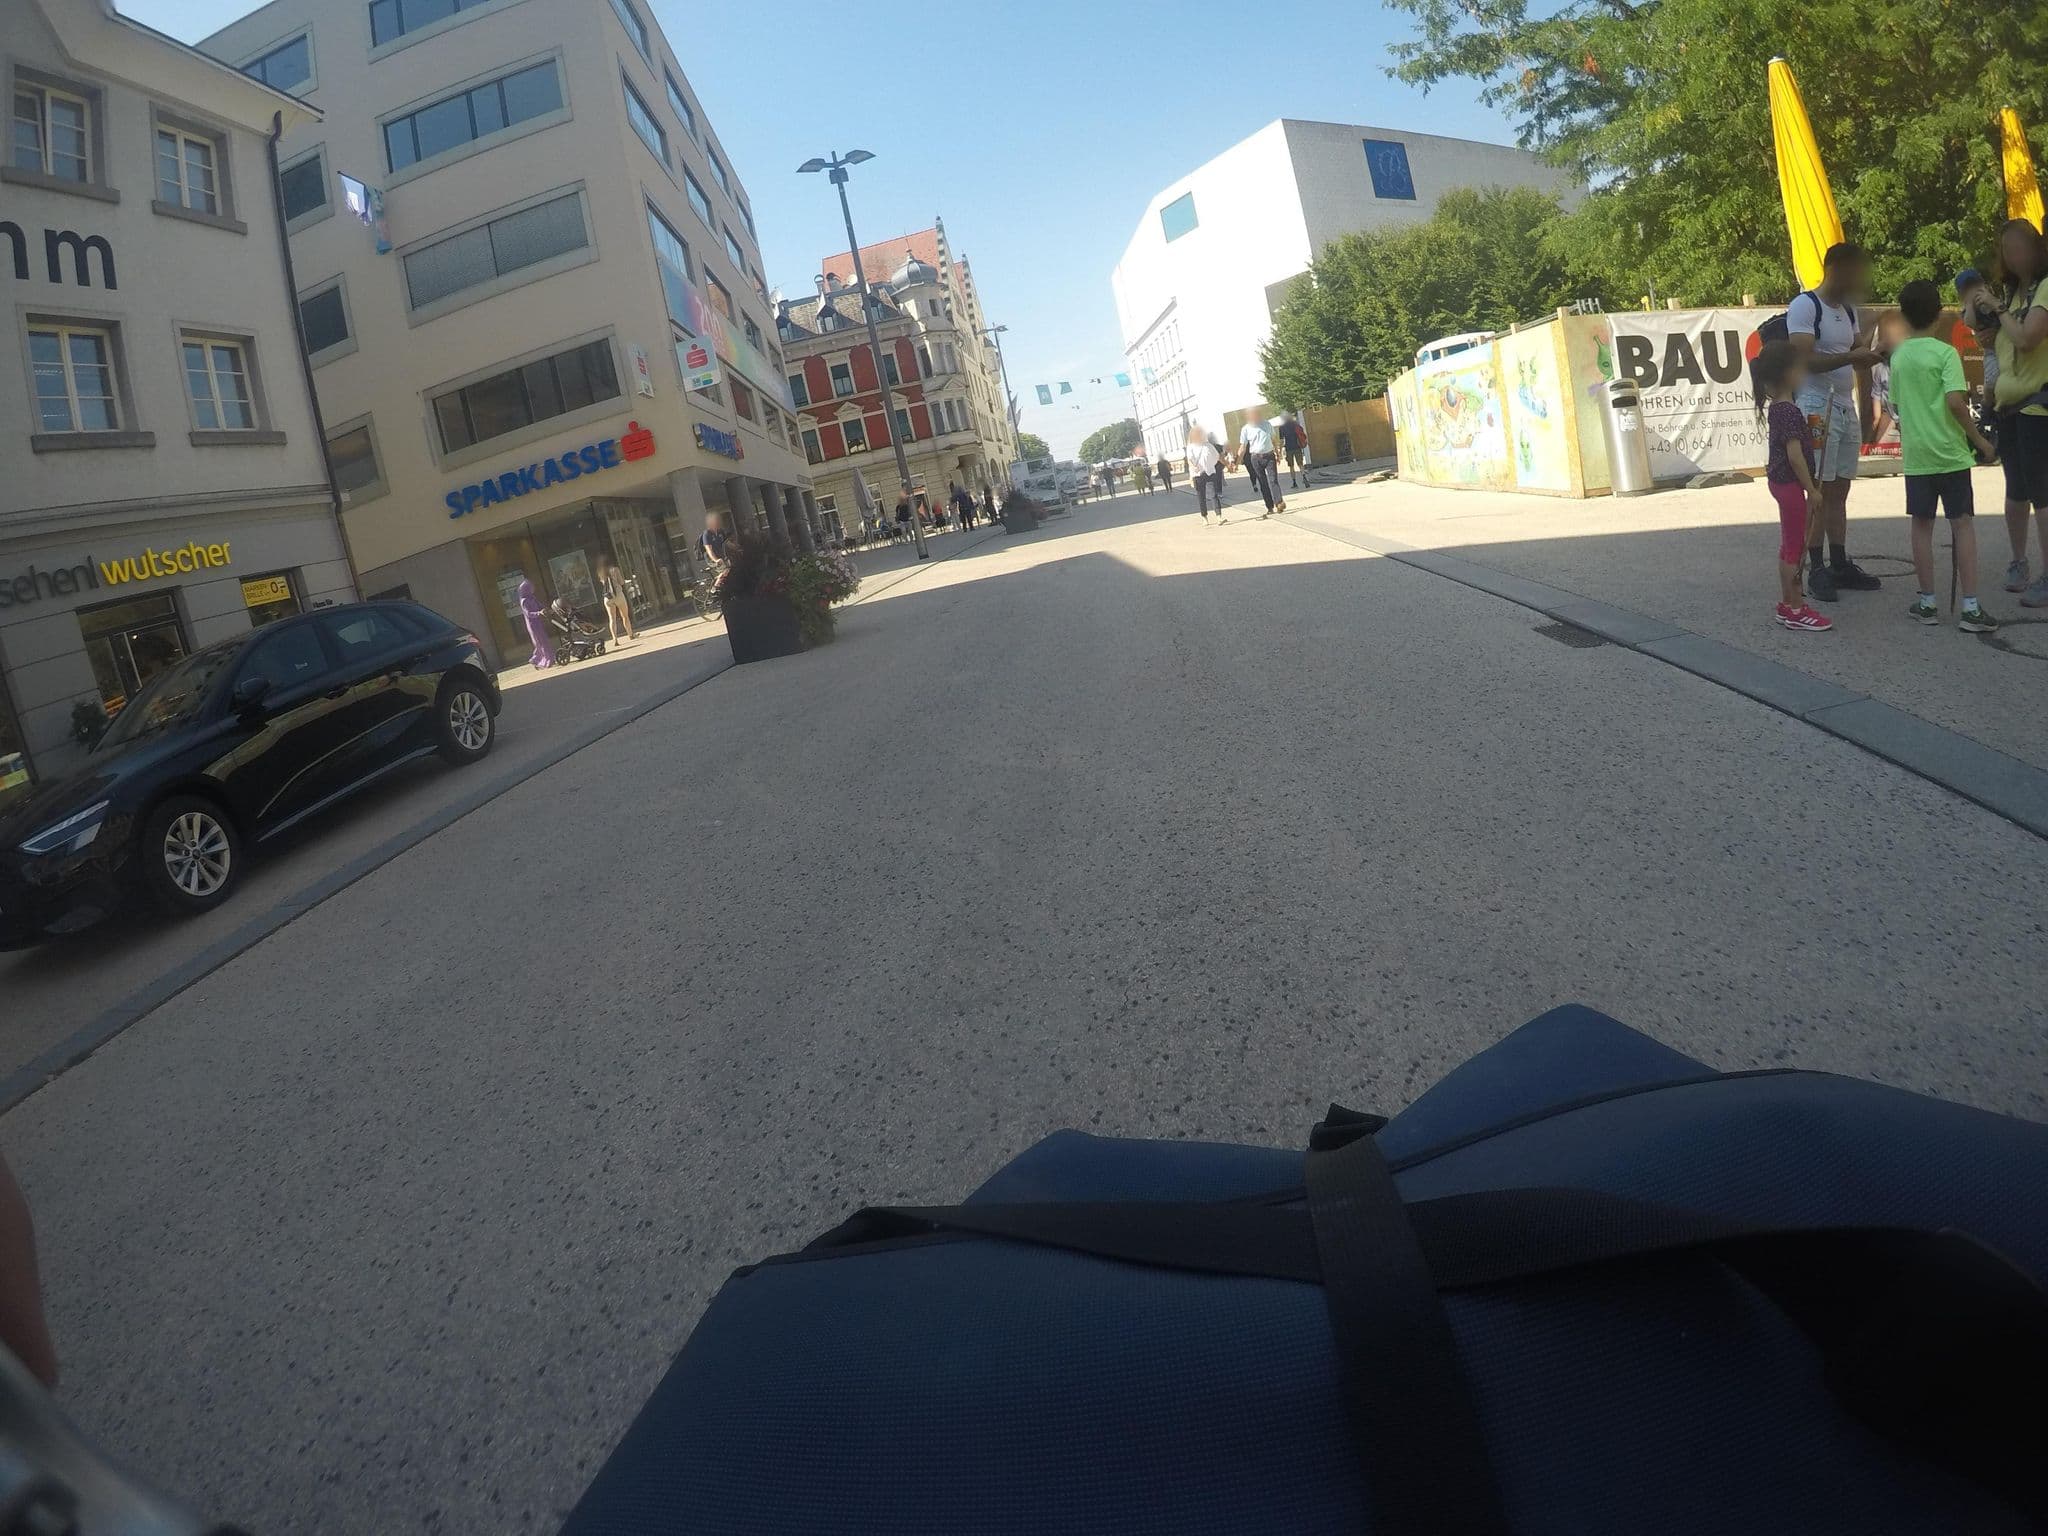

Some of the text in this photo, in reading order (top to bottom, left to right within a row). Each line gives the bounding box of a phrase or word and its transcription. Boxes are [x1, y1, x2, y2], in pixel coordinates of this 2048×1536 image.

[1615, 330, 1743, 389] BAU
[1641, 395, 1683, 410] HREN
[1689, 392, 1712, 405] und
[1701, 416, 1743, 429] Schneiden
[1650, 439, 1671, 454] +43
[1675, 437, 1689, 455] (0)
[1692, 437, 1713, 450] 664
[1727, 432, 1746, 447] 190
[445, 438, 621, 519] SPARKASSE
[100, 540, 232, 586] wutscher
